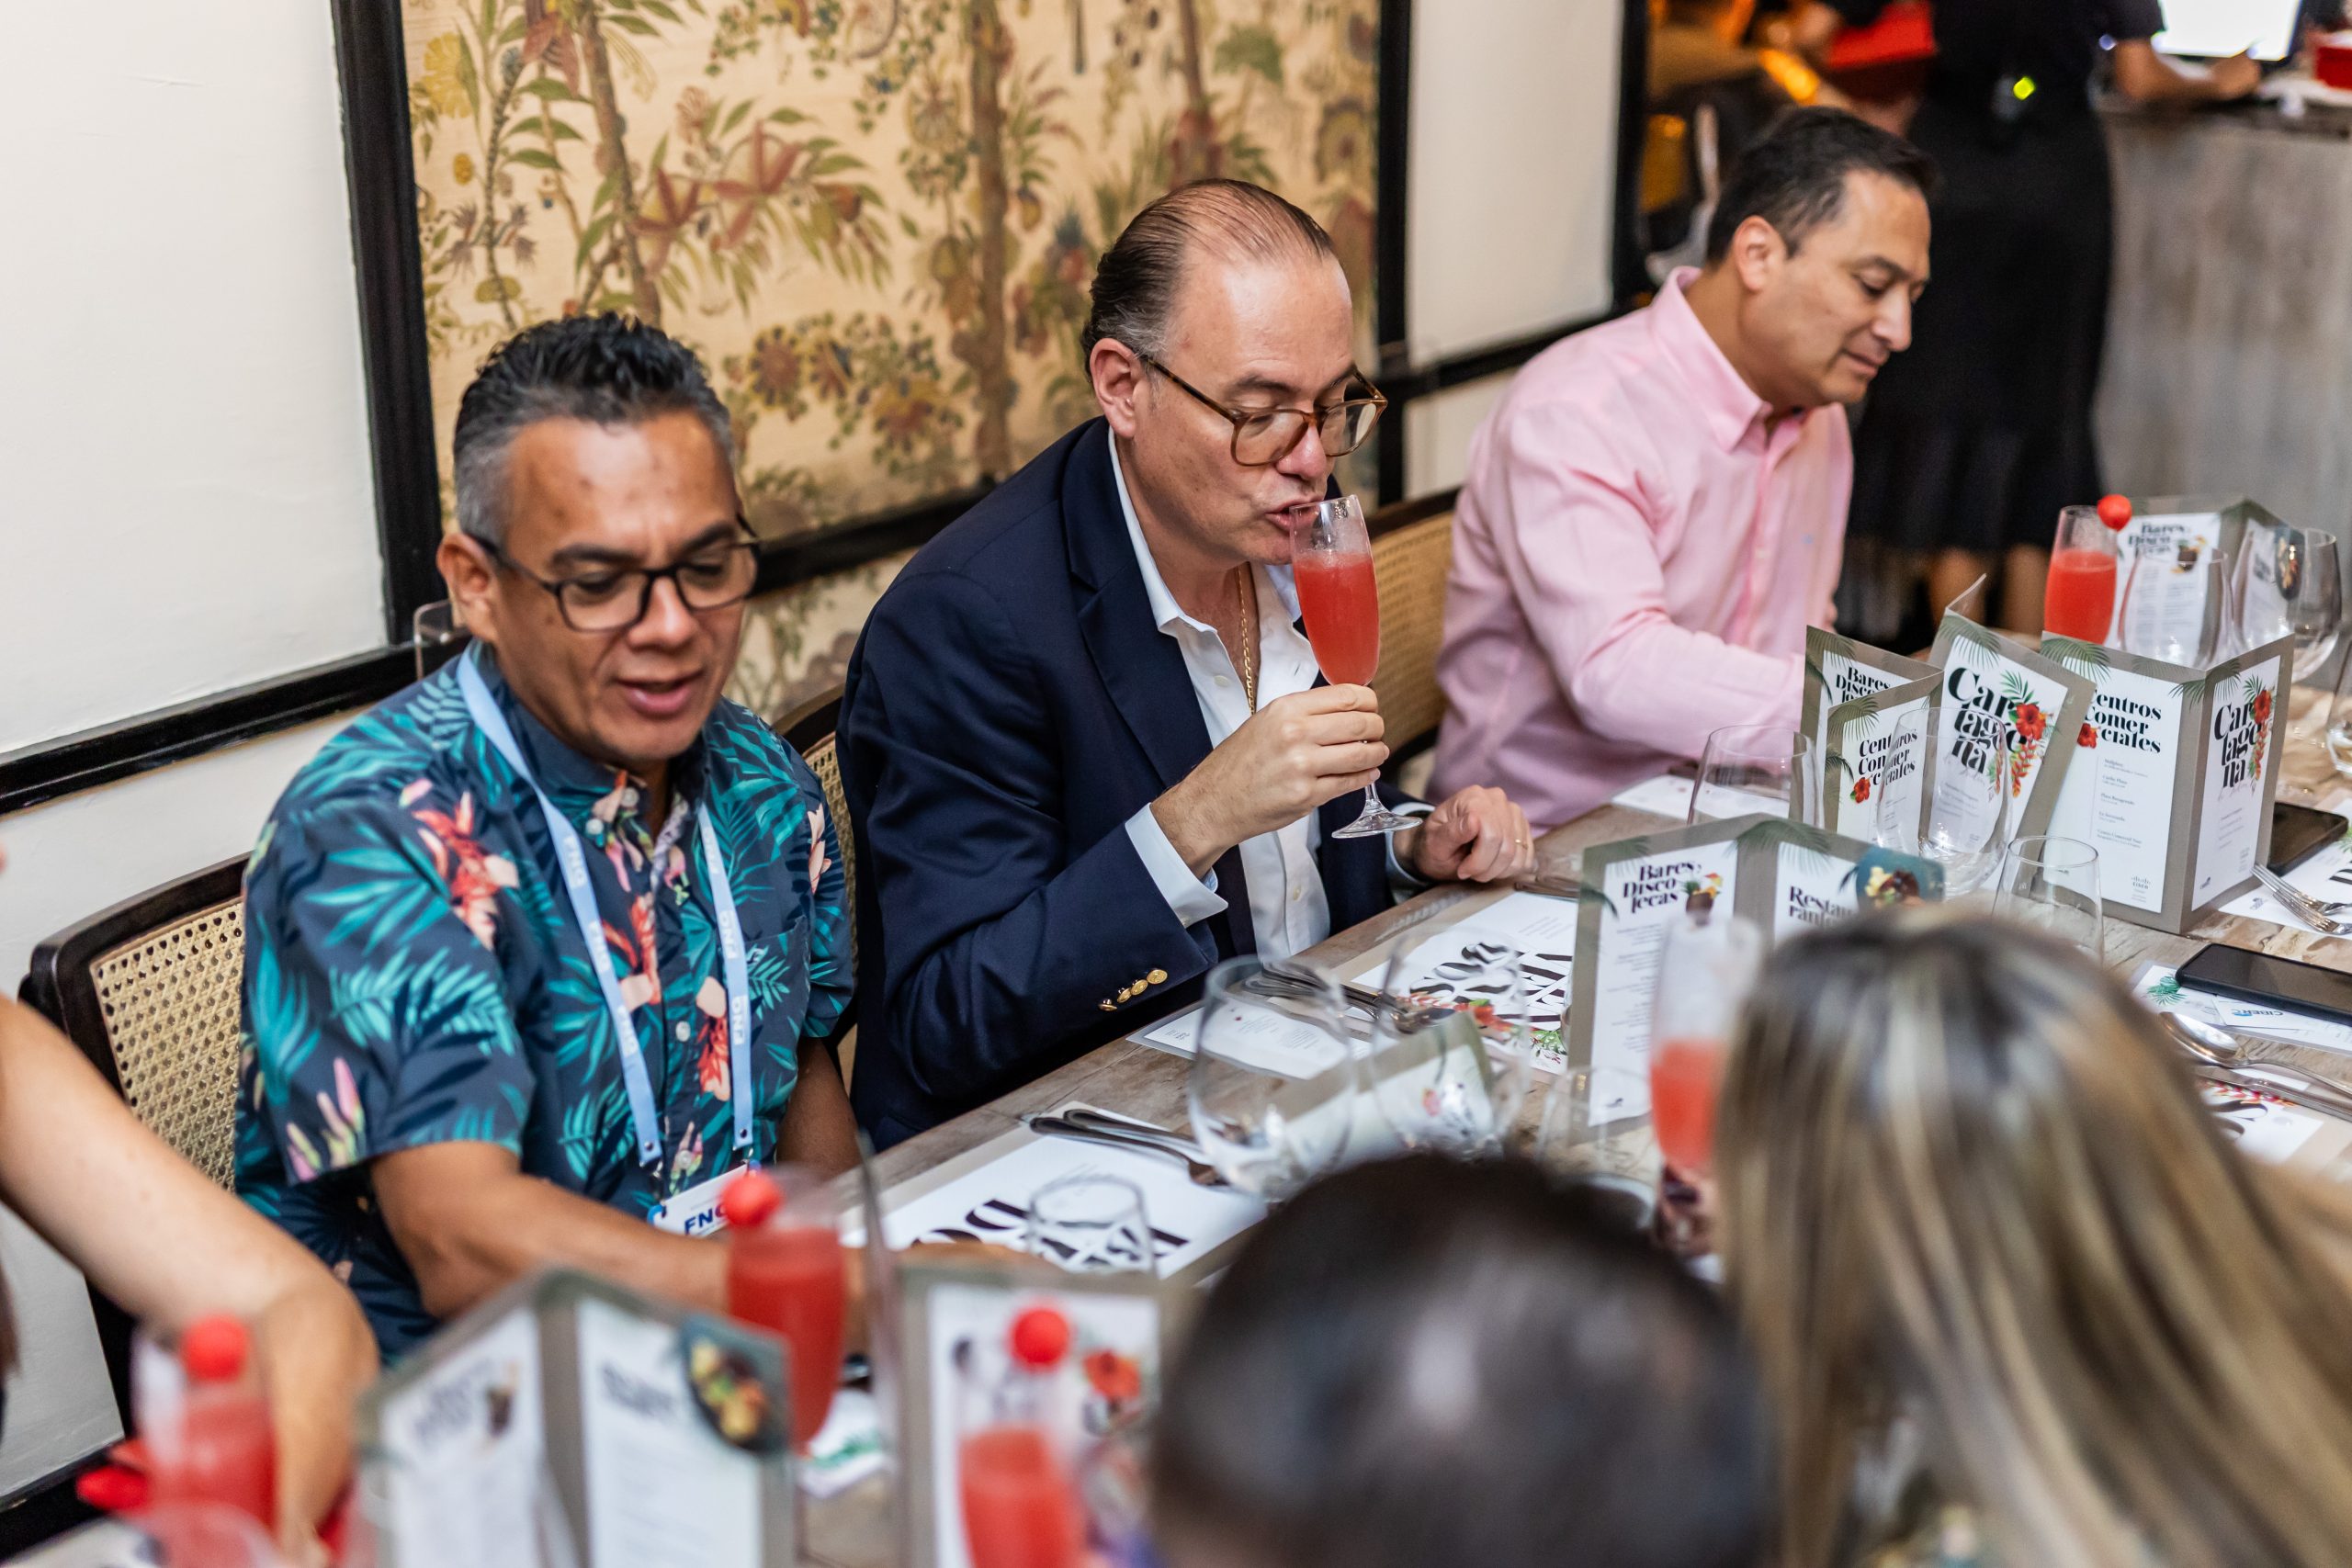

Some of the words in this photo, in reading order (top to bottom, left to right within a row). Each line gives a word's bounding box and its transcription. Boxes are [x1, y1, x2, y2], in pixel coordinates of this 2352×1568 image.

[1848, 667, 1891, 691] Bares
[1948, 667, 2015, 718] Car
[2096, 690, 2162, 721] entros
[2214, 704, 2253, 740] Car
[1859, 729, 1918, 758] Centros
[2100, 728, 2161, 754] ciales
[1951, 736, 1987, 774] na
[1872, 761, 1916, 785] ciales
[2222, 759, 2246, 787] na
[1640, 862, 1694, 882] Bares
[1623, 878, 1677, 898] Disco
[1632, 892, 1679, 913] tecas
